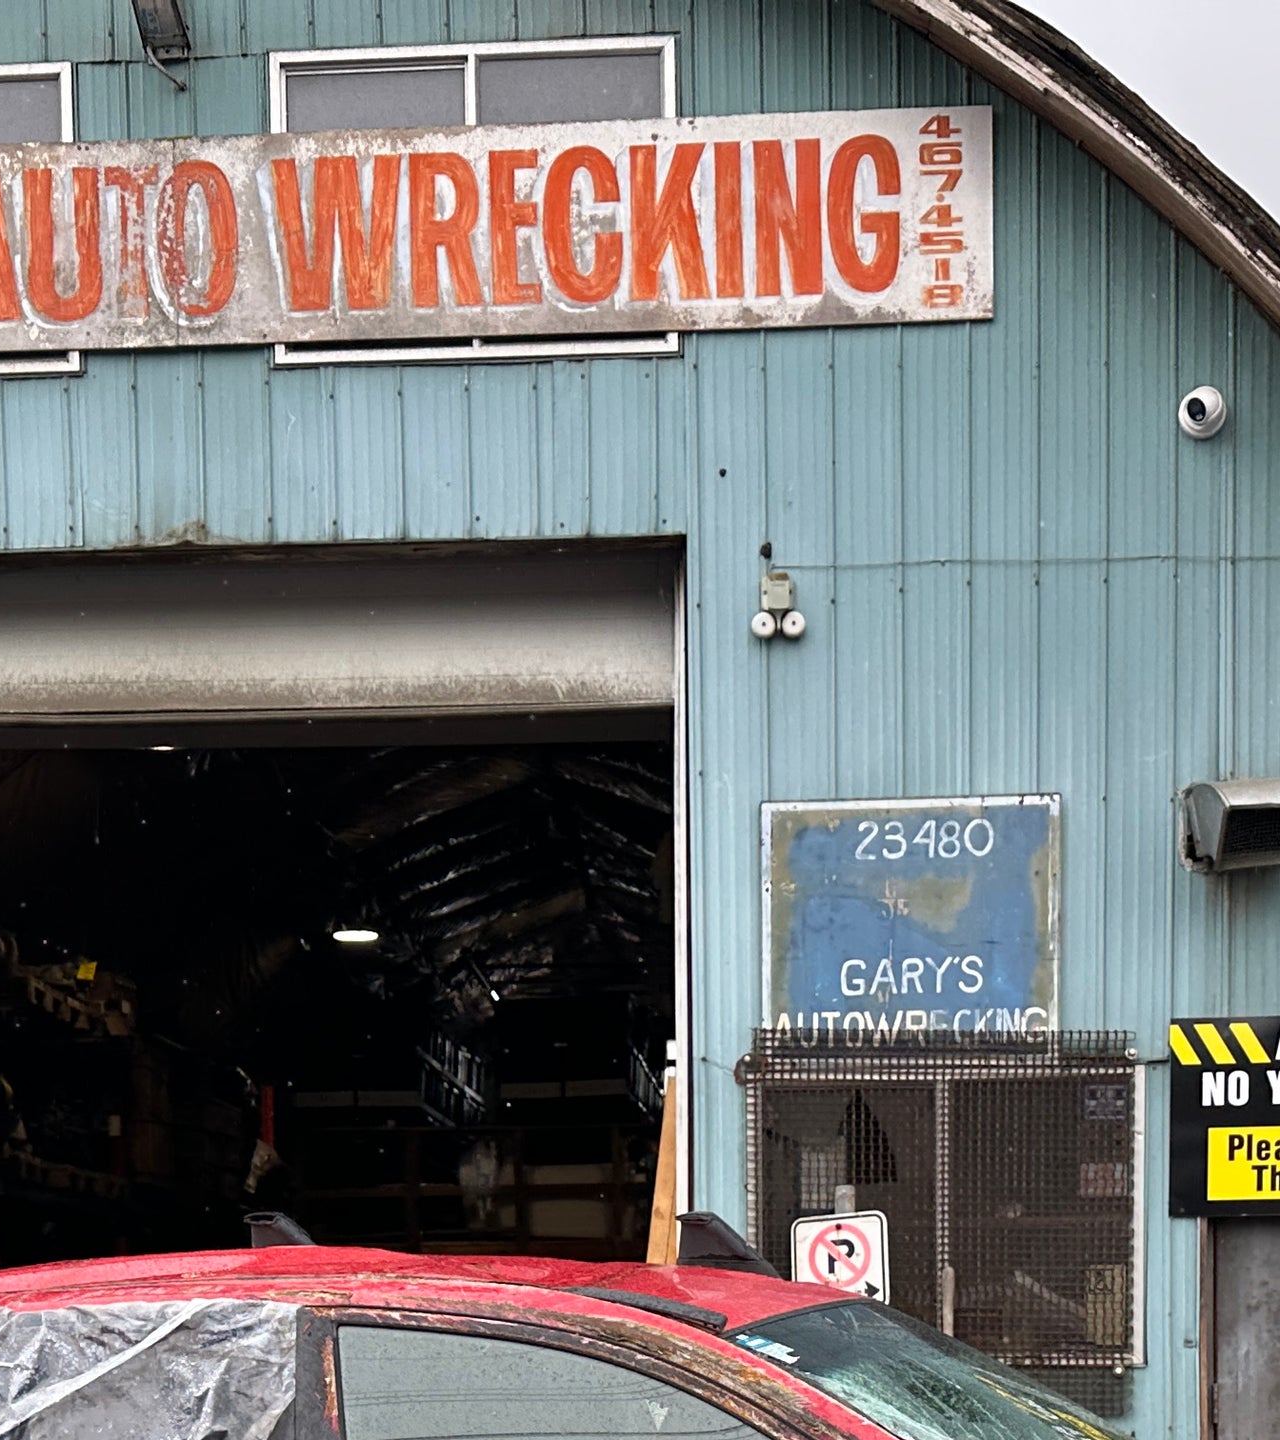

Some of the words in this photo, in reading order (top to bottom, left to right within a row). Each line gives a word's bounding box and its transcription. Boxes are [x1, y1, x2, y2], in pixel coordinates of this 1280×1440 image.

[271, 133, 902, 312] WRECKING
[854, 817, 995, 861] 23480
[839, 956, 984, 997] GARY'S
[1201, 1070, 1250, 1107] NO
